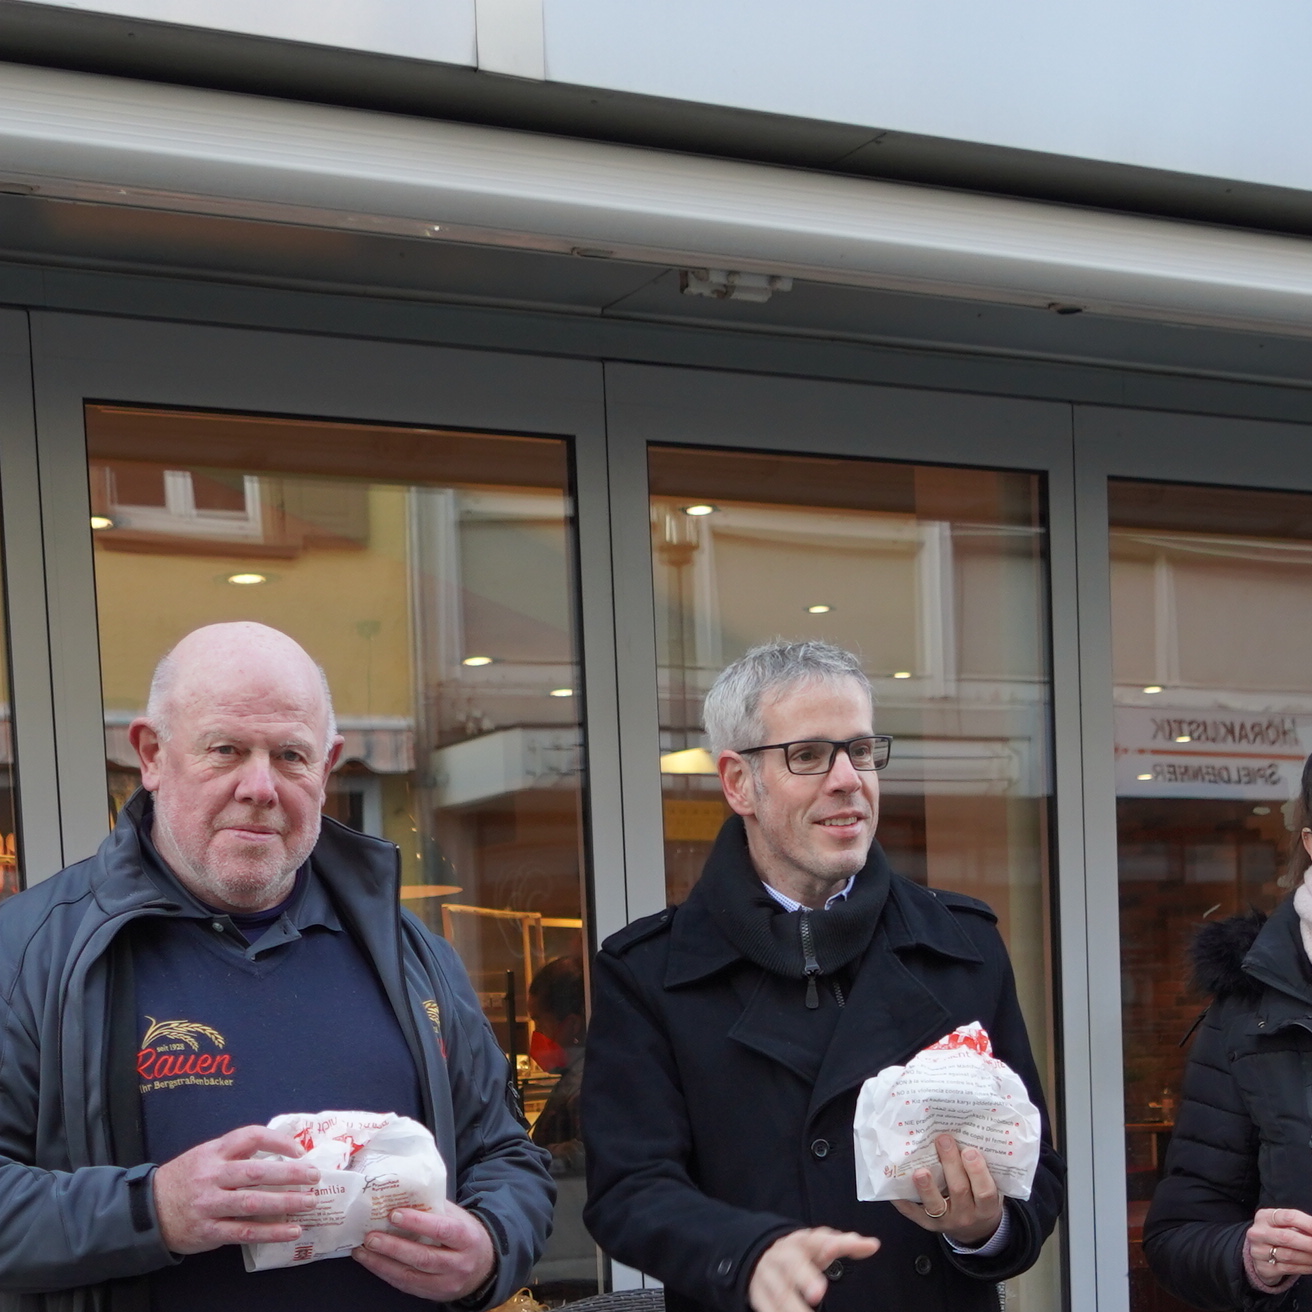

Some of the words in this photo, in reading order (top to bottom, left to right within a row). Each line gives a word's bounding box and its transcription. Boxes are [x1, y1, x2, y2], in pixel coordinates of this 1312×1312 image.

[169, 1043, 185, 1051] 1928
[135, 1048, 235, 1080] Rauen
[139, 1083, 152, 1094] Ihr
[153, 1076, 233, 1090] Bergstraßenbäcker
